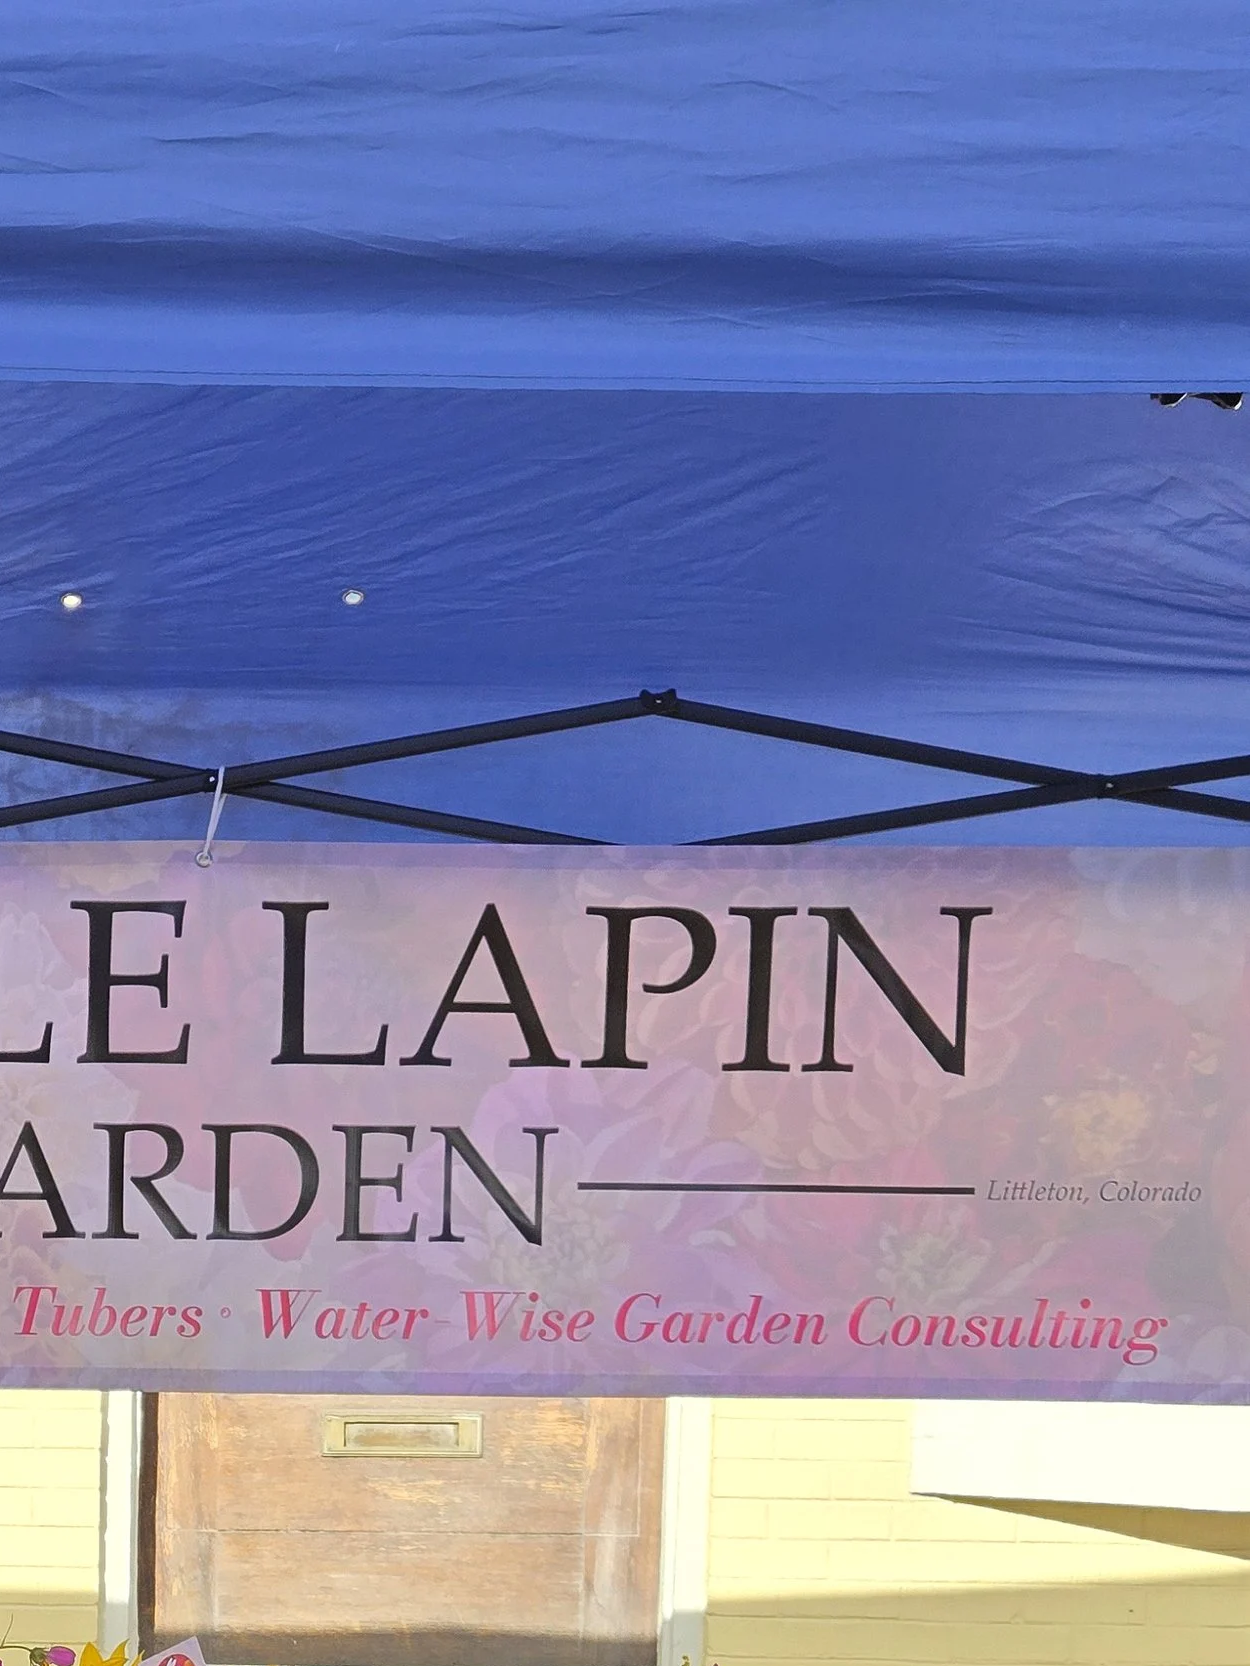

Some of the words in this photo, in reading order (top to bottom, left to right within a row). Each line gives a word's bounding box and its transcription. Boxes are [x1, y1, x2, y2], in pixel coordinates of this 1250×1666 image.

[262, 900, 993, 1077] LAPIN
[986, 1177, 1091, 1206] Littleton,
[1098, 1178, 1203, 1204] Colorado
[12, 1285, 204, 1341] Tubers
[614, 1292, 829, 1347] Garden
[848, 1295, 1170, 1366] Consulting
